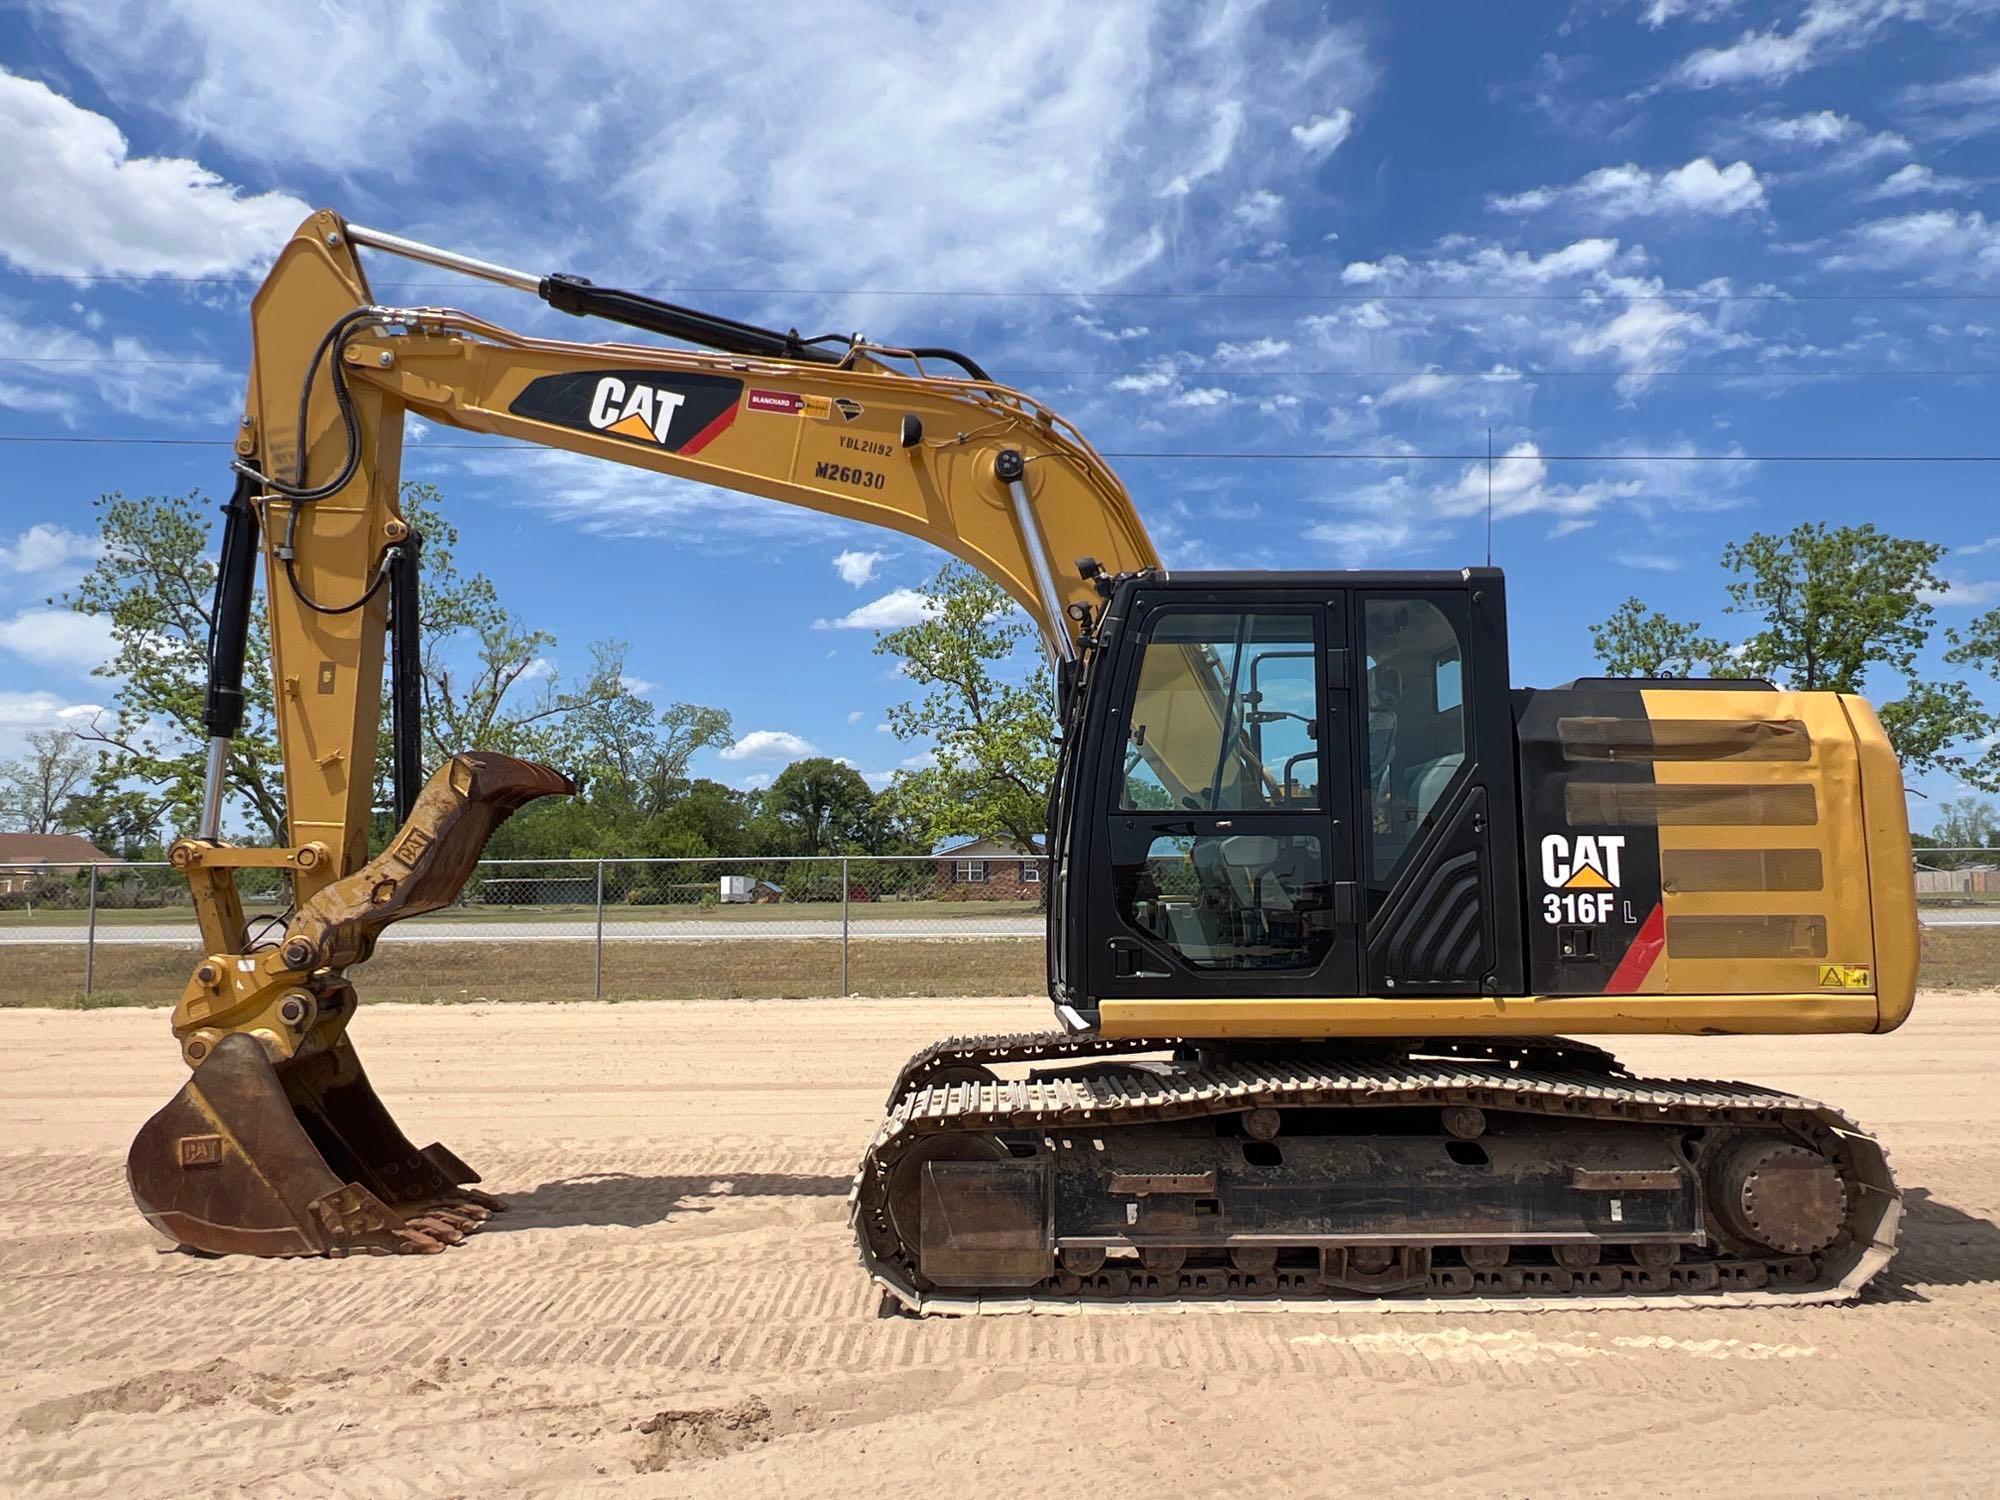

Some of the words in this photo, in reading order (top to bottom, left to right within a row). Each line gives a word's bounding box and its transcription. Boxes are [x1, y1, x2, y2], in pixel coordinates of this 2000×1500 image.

[589, 377, 685, 444] CAT
[752, 396, 790, 407] BLANCHARD
[840, 435, 893, 457] YDL21192
[816, 461, 885, 490] M26030
[398, 831, 428, 865] CAT
[1541, 834, 1625, 888] CAT
[1543, 893, 1614, 924] 316F
[1623, 900, 1637, 923] L
